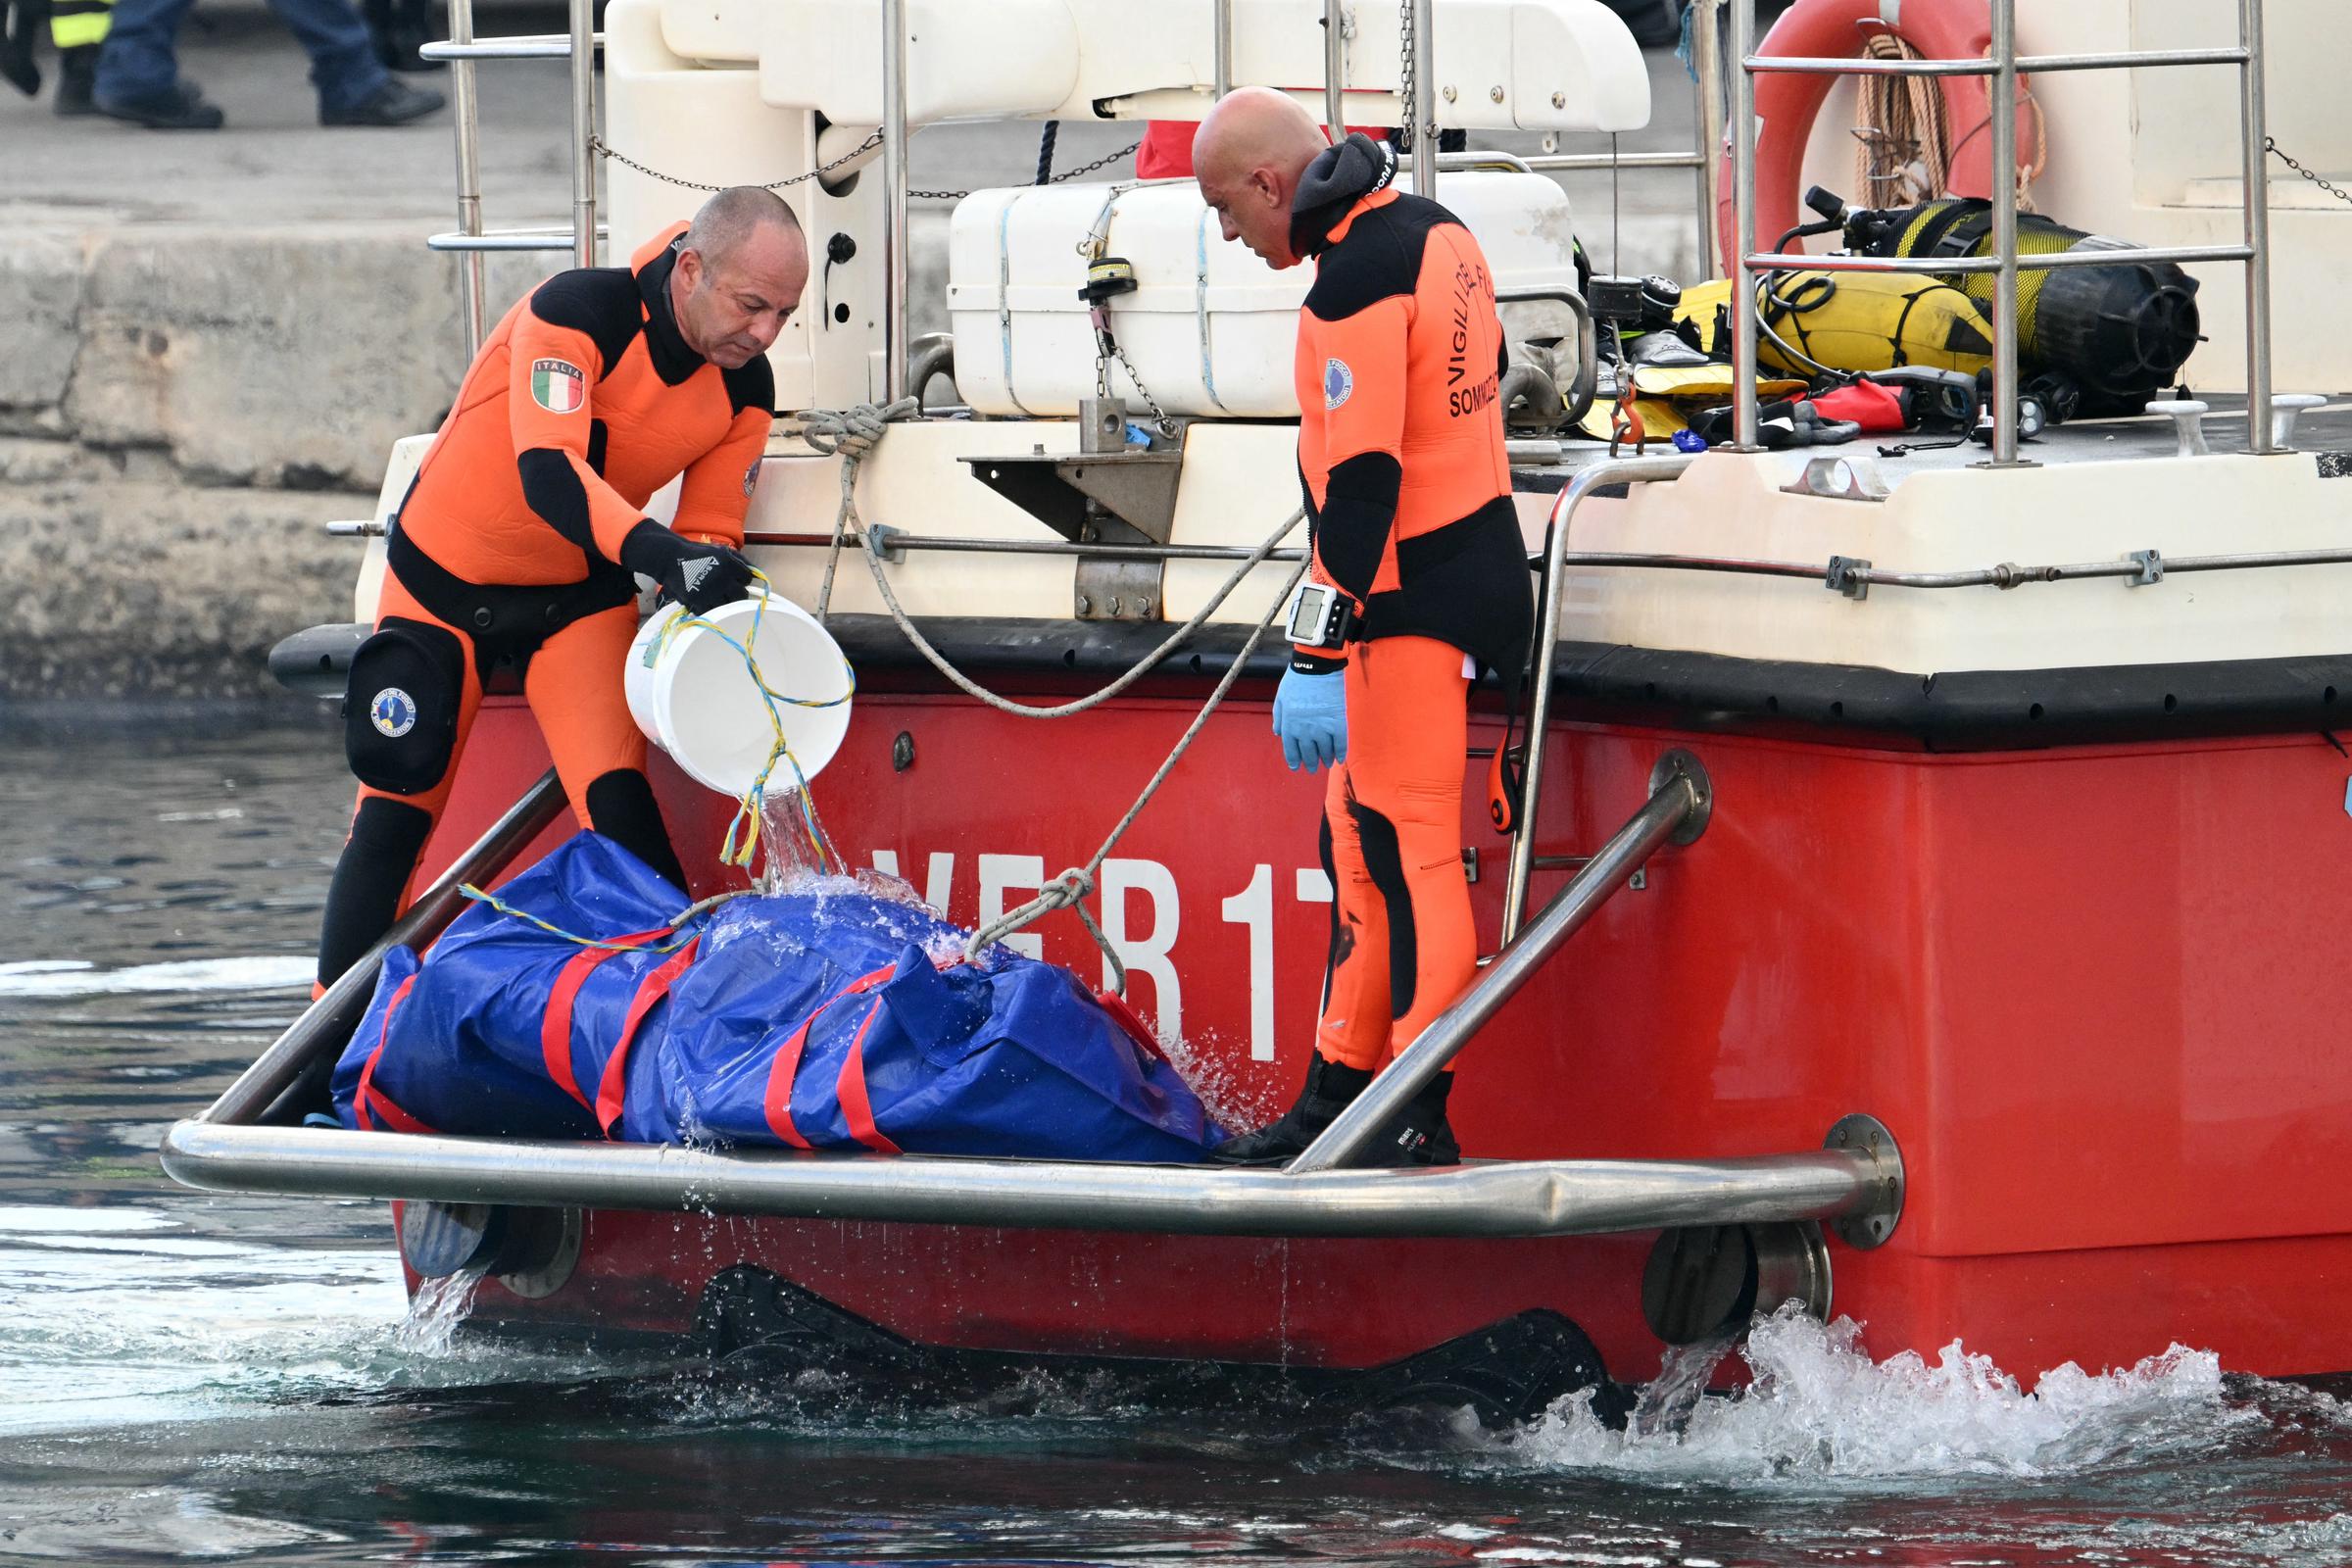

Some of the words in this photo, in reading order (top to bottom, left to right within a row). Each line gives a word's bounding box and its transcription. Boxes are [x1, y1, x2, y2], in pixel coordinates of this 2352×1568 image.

[536, 362, 580, 378] ITALIA
[1331, 360, 1349, 377] FUOCO
[690, 556, 720, 592] ASORAL
[1220, 863, 1333, 1062] 1
